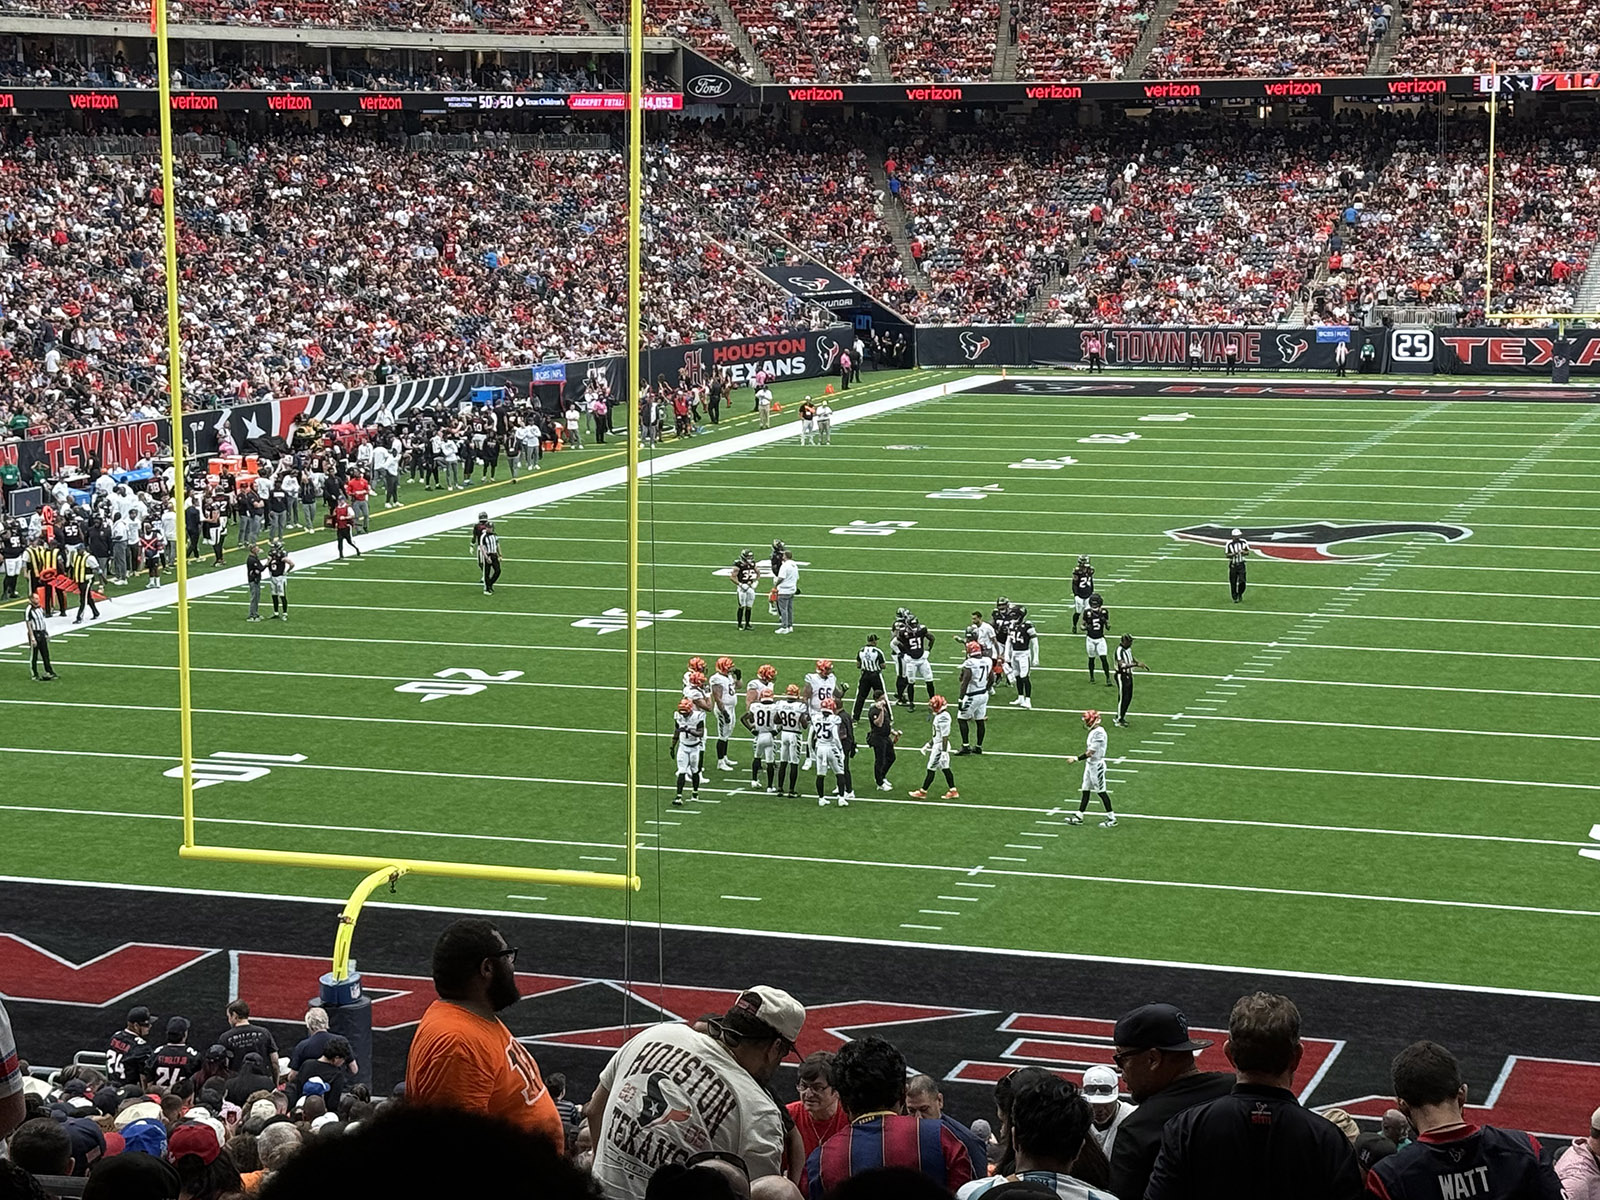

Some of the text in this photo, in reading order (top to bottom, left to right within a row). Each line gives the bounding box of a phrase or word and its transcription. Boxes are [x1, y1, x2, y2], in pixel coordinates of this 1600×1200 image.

[694, 79, 723, 94] Ford
[789, 86, 843, 101] verizon
[906, 85, 962, 101] verizon
[1026, 83, 1082, 99] verizon
[1144, 82, 1201, 98] verizon
[1265, 80, 1322, 96] verizon
[1388, 78, 1447, 93] verizon
[70, 92, 119, 109] verizon
[171, 92, 218, 110] verizon
[267, 94, 312, 110] verizon
[359, 95, 402, 110] verizon
[713, 338, 806, 362] HOUSTON
[1112, 331, 1186, 363] TOWN
[1190, 331, 1261, 364] MADE
[1398, 335, 1427, 357] 25
[718, 356, 806, 383] TEXANS
[44, 422, 158, 476] TEXANS
[65, 525, 78, 537] 55
[829, 519, 919, 536] 50
[571, 607, 683, 630] 30
[1092, 618, 1101, 631] 5
[909, 638, 922, 650] 51
[394, 667, 525, 696] 20
[818, 687, 832, 700] 66
[757, 710, 770, 728] 81
[815, 722, 831, 739] 25
[163, 750, 308, 784] 10
[106, 1049, 126, 1079] 24
[624, 1042, 737, 1140] HOUSTON
[607, 1106, 690, 1169] TEXANS
[1438, 1166, 1490, 1200] WATT
